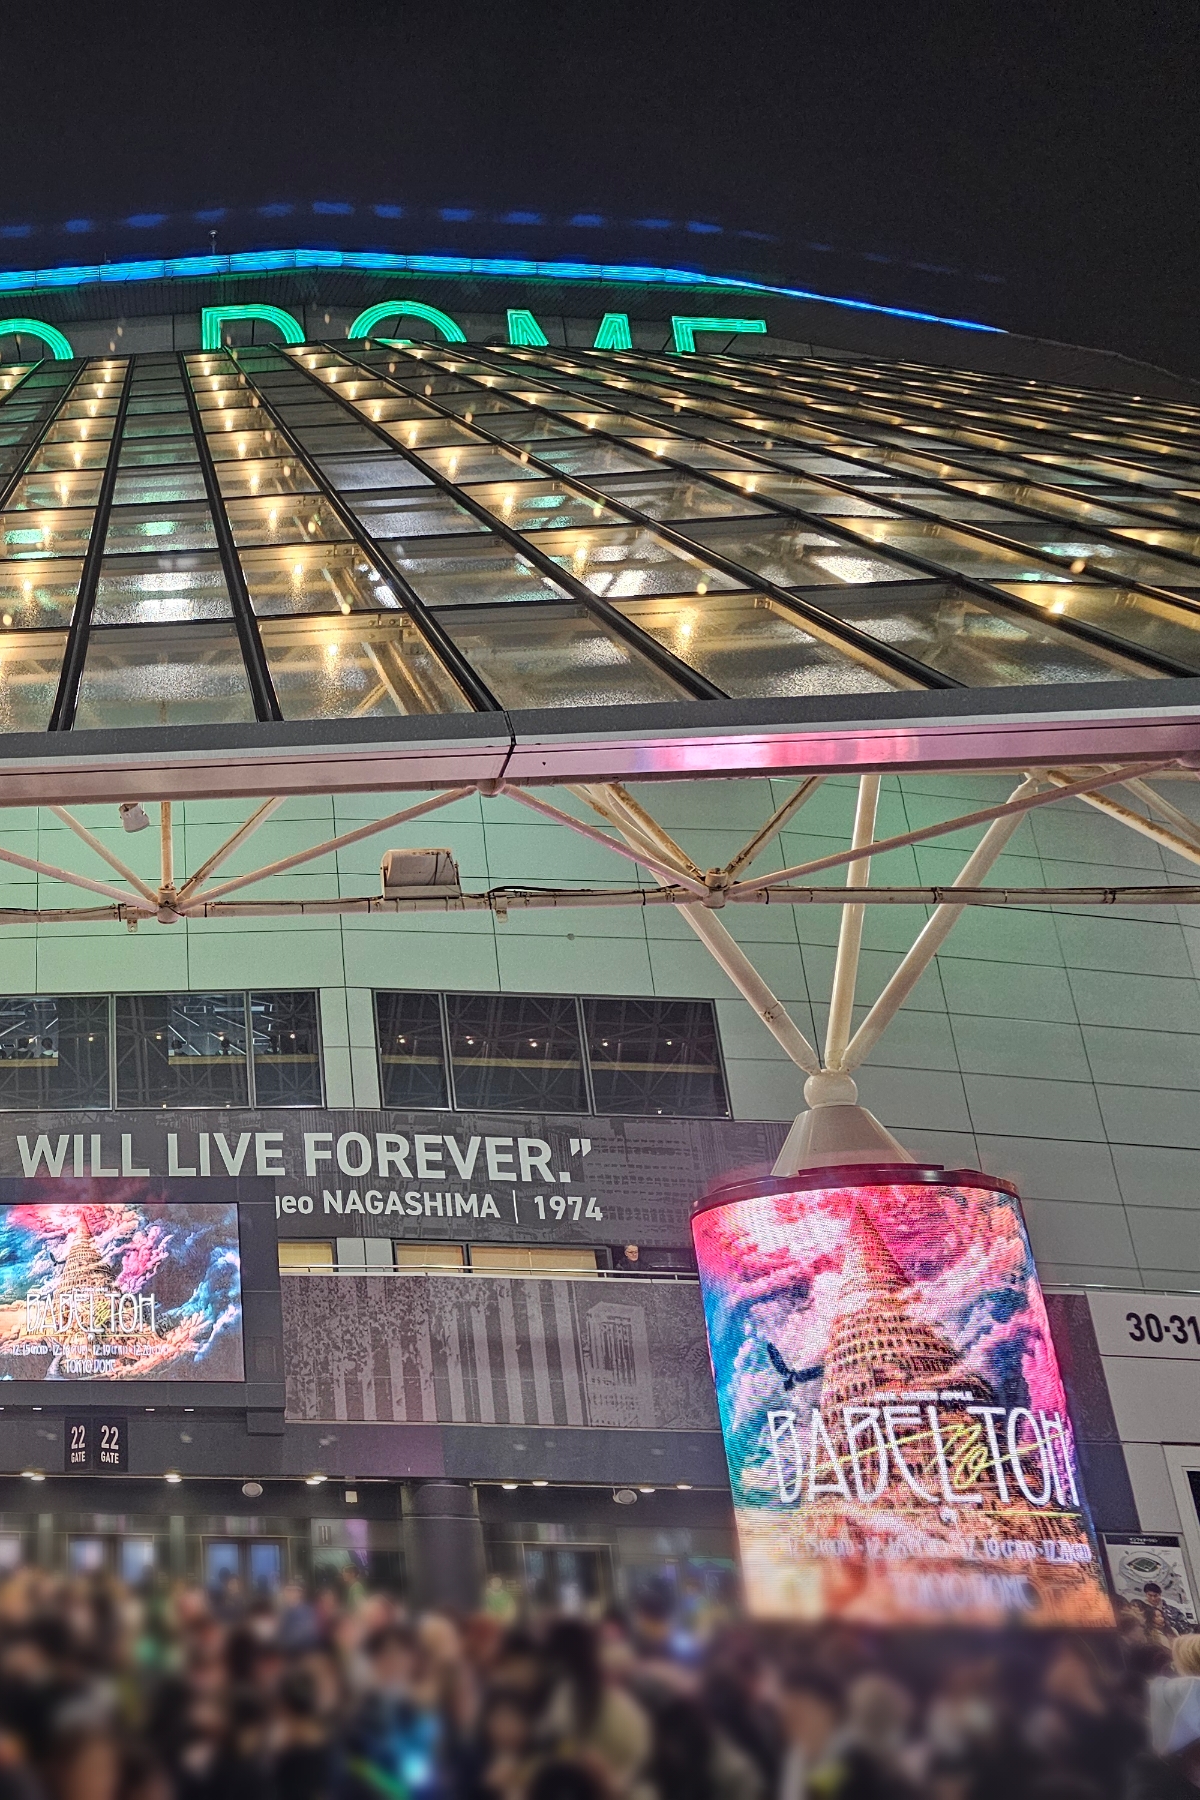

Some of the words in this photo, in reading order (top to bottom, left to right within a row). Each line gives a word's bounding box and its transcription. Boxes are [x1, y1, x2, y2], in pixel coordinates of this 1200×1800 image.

[17, 1133, 150, 1178] WILL
[168, 1132, 286, 1177] LIVE
[323, 1189, 501, 1218] NAGASHIMA
[534, 1195, 604, 1221] 1974
[71, 1425, 85, 1450] 22
[101, 1425, 119, 1450] 22
[70, 1451, 86, 1463] GATE
[100, 1451, 120, 1464] GATE
